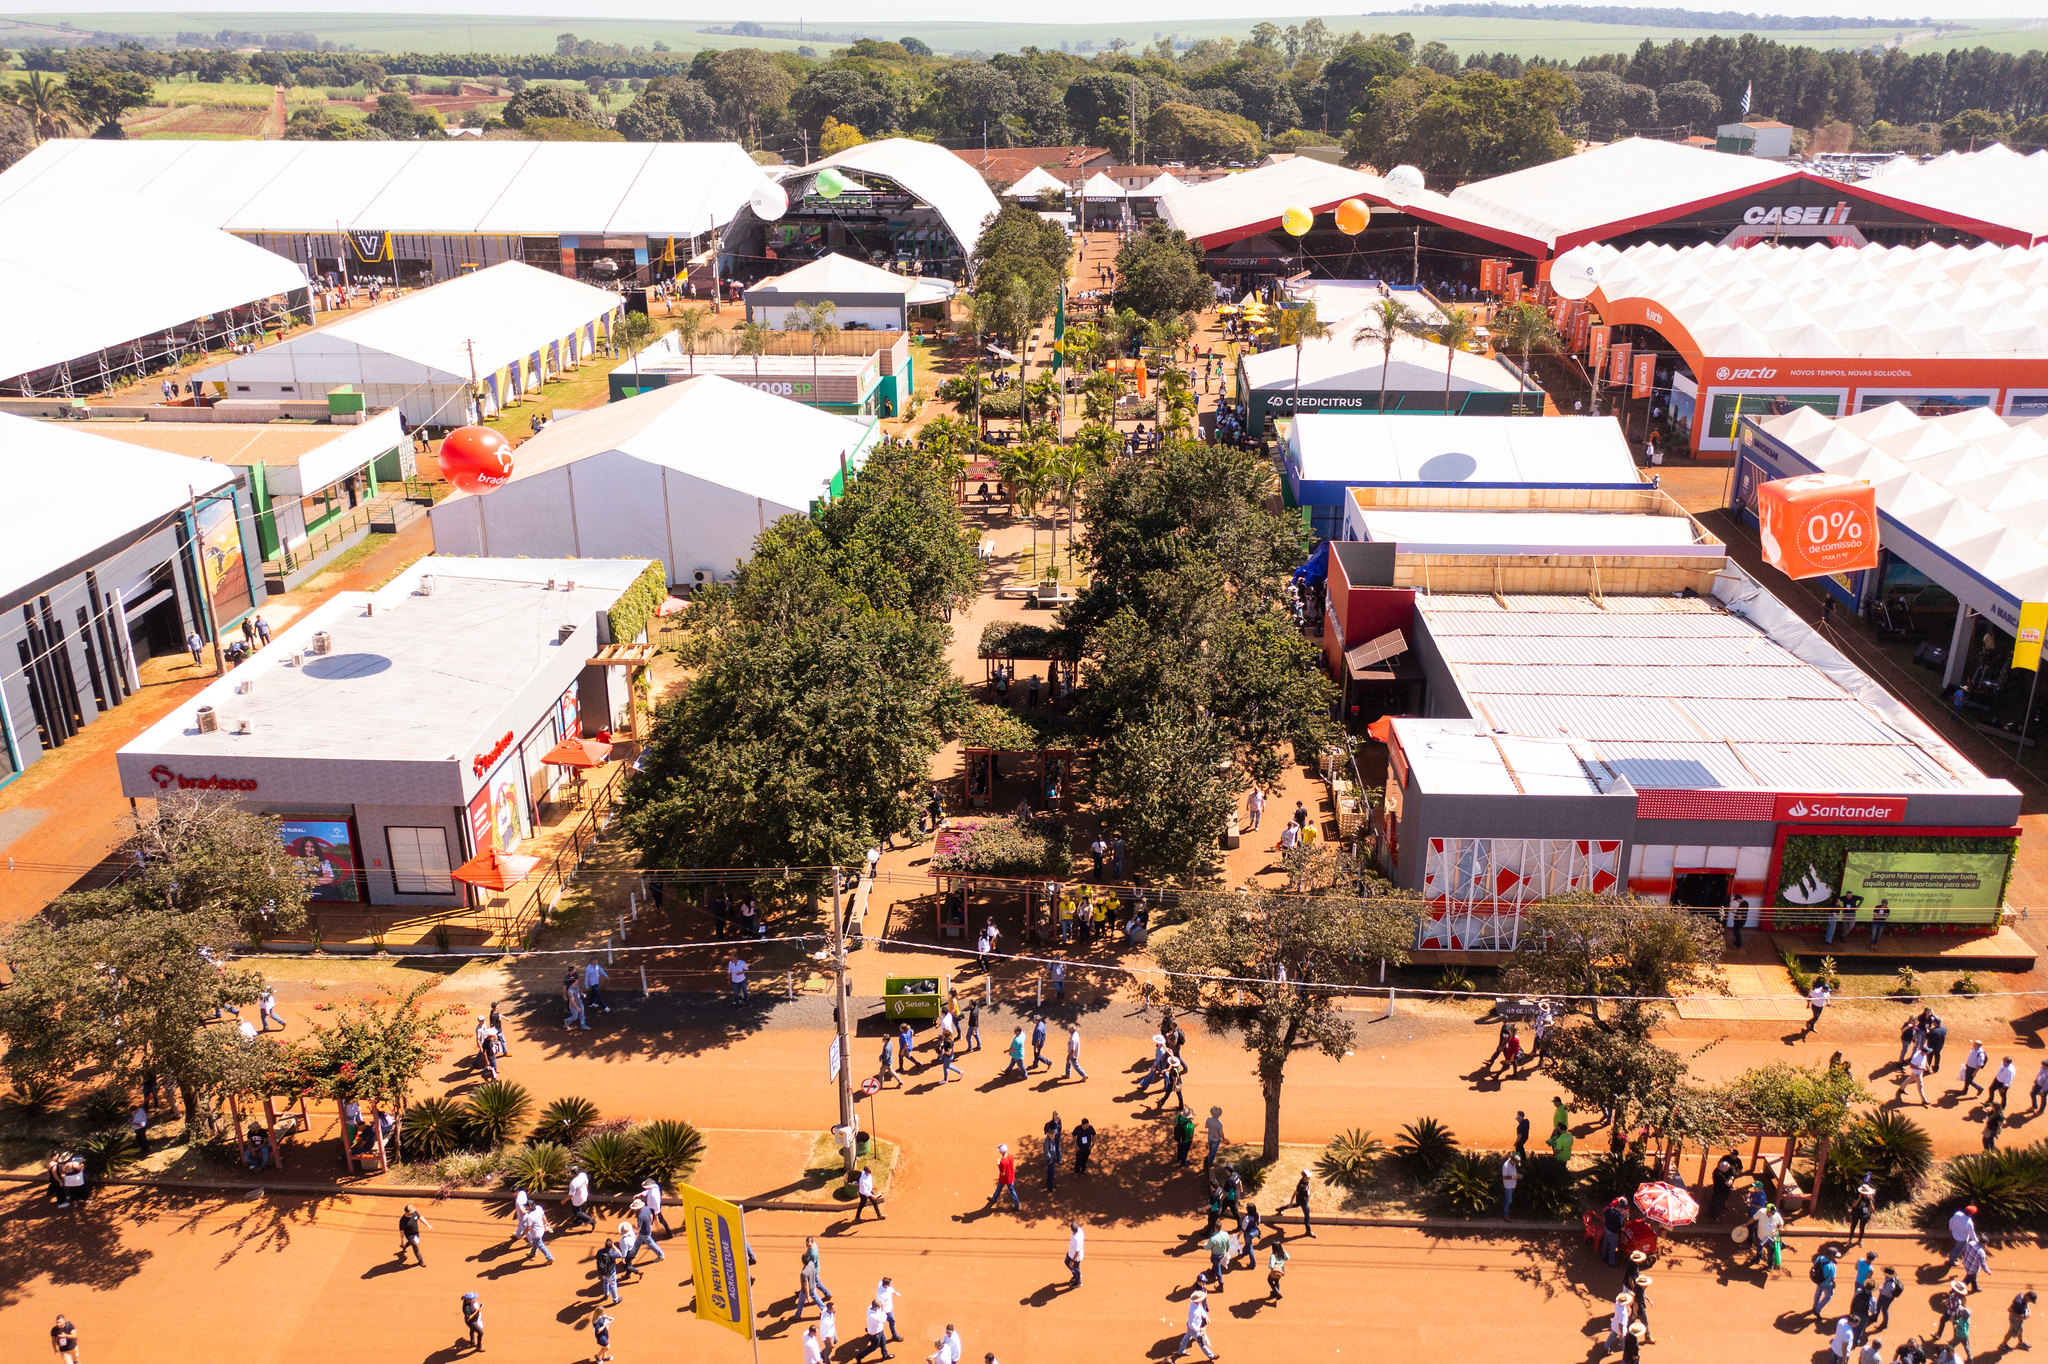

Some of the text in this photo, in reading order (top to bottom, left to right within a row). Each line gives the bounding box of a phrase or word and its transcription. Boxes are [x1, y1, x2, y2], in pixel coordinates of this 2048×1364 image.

[1743, 206, 1825, 225] CASE
[1728, 367, 1778, 381] jacto
[1790, 369, 1816, 377] NOVOS
[1817, 369, 1847, 378] TEMPOS,
[1873, 369, 1913, 378] SOLUÇÕES.
[1285, 397, 1363, 407] CREDICITRUS
[1808, 510, 1862, 544] 0%
[1808, 540, 1863, 554] de comissão
[177, 773, 258, 792] bradesco
[1810, 804, 1892, 818] Santander
[1871, 872, 1896, 880] Seguro
[1896, 872, 1913, 880] feito
[1930, 874, 1960, 882] proteger
[1864, 881, 1886, 889] aquilo
[1905, 881, 1943, 889] importante
[905, 1000, 930, 1008] Seleta
[703, 1217, 723, 1293] NEW HOLLAND
[721, 1240, 737, 1300] AGRICULTURE
